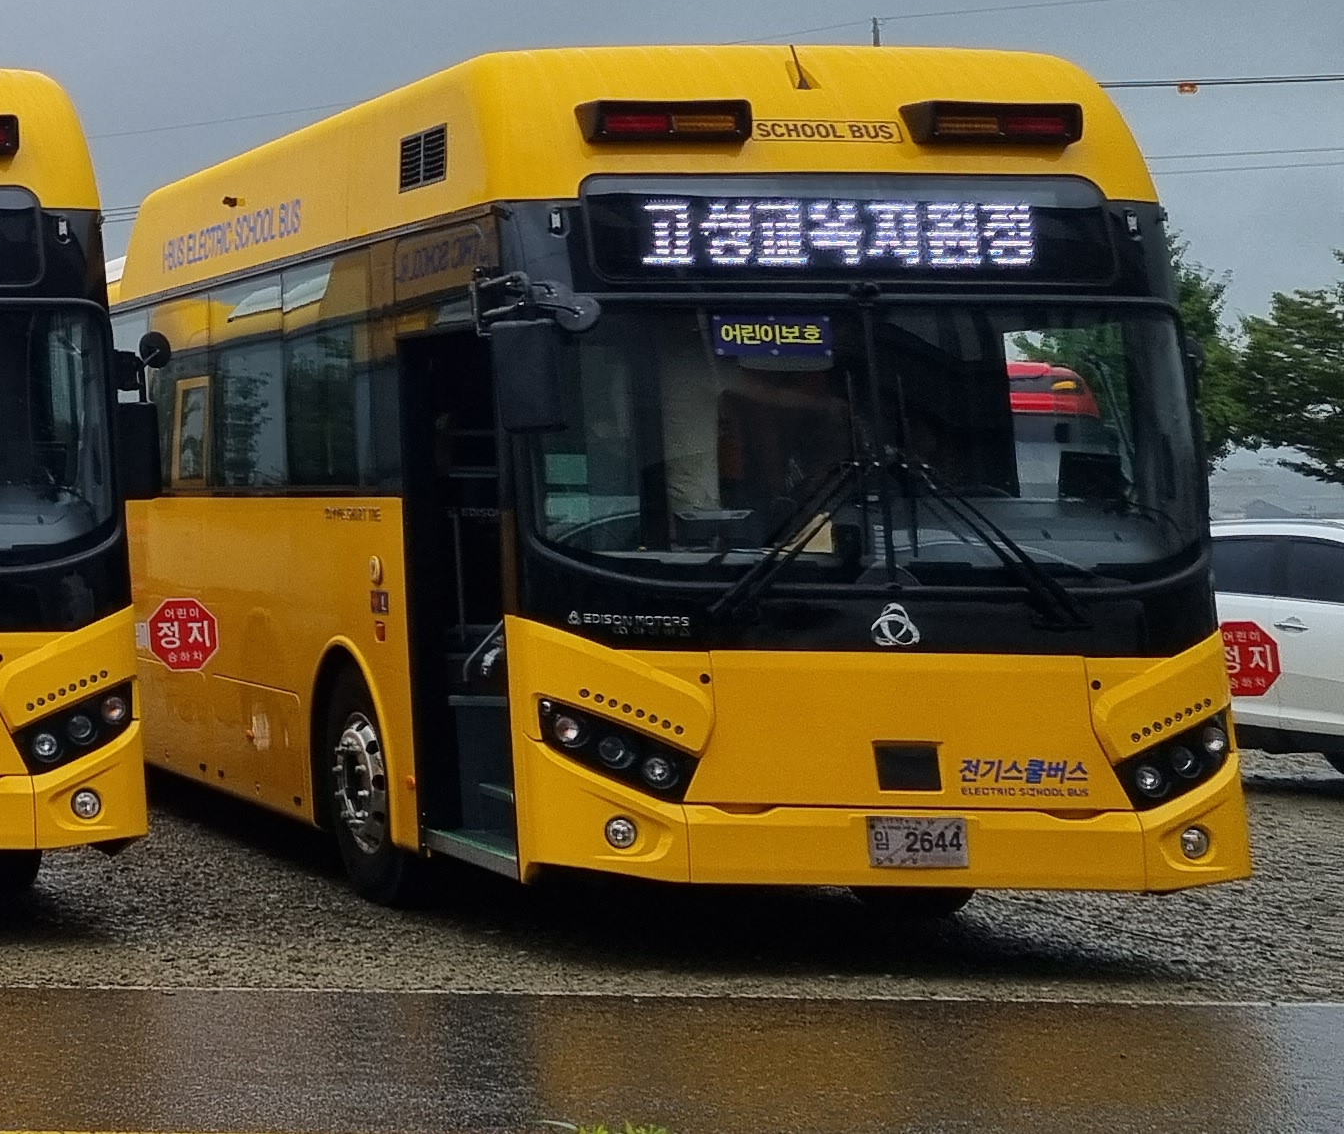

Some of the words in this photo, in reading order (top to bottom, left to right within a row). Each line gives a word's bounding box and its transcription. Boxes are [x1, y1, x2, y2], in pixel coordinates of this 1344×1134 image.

[756, 122, 845, 139] SCHOOL
[848, 124, 894, 139] BUS
[186, 221, 232, 264] ELECTRIC
[234, 207, 276, 250] SCHOOL
[279, 198, 301, 238] BUS
[721, 324, 823, 345] 어린이보호
[164, 607, 199, 619] 어린이
[583, 613, 632, 626] EDISON
[157, 620, 210, 648] 정지
[959, 759, 1088, 783] 전기스쿨버스
[961, 787, 1016, 797] ELECTRIC
[1019, 787, 1065, 797] SCHOOL
[1067, 788, 1090, 798] BUS
[874, 831, 889, 850] 임
[905, 831, 963, 853] 2644
